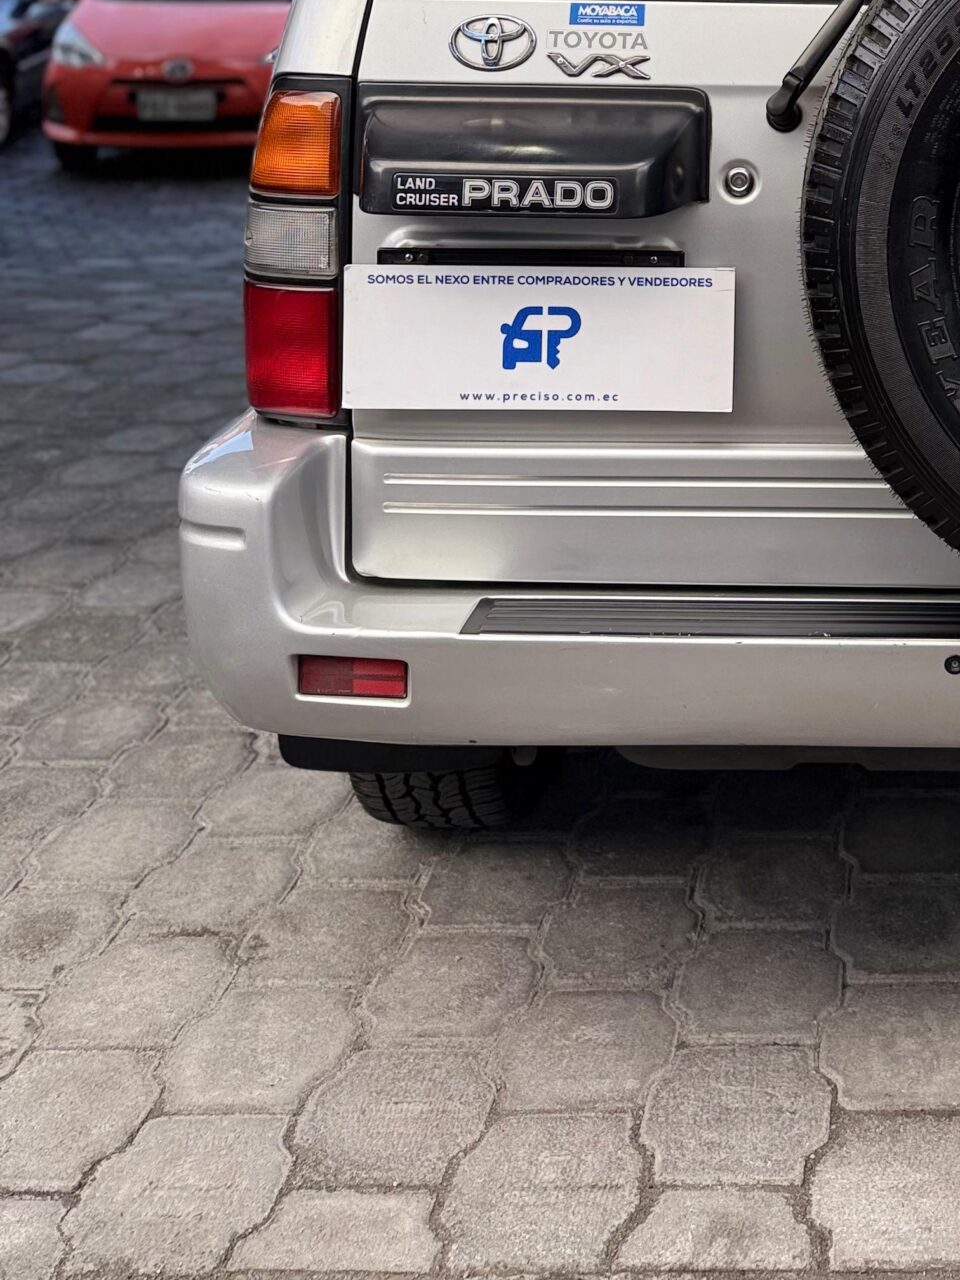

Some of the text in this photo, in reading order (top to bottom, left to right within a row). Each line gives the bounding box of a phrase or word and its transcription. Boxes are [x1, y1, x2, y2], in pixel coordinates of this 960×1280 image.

[577, 4, 637, 17] MOYABACA
[549, 30, 648, 50] TOYOTA
[546, 52, 652, 80] VX
[397, 177, 435, 190] LAND
[396, 193, 459, 207] CRUISER
[461, 178, 614, 210] PRADO
[367, 274, 713, 288] SOMOS EL NEXO ENTRE COMPRADORES Y VENDEDORES
[459, 391, 620, 403] www.preciso.com.ec
